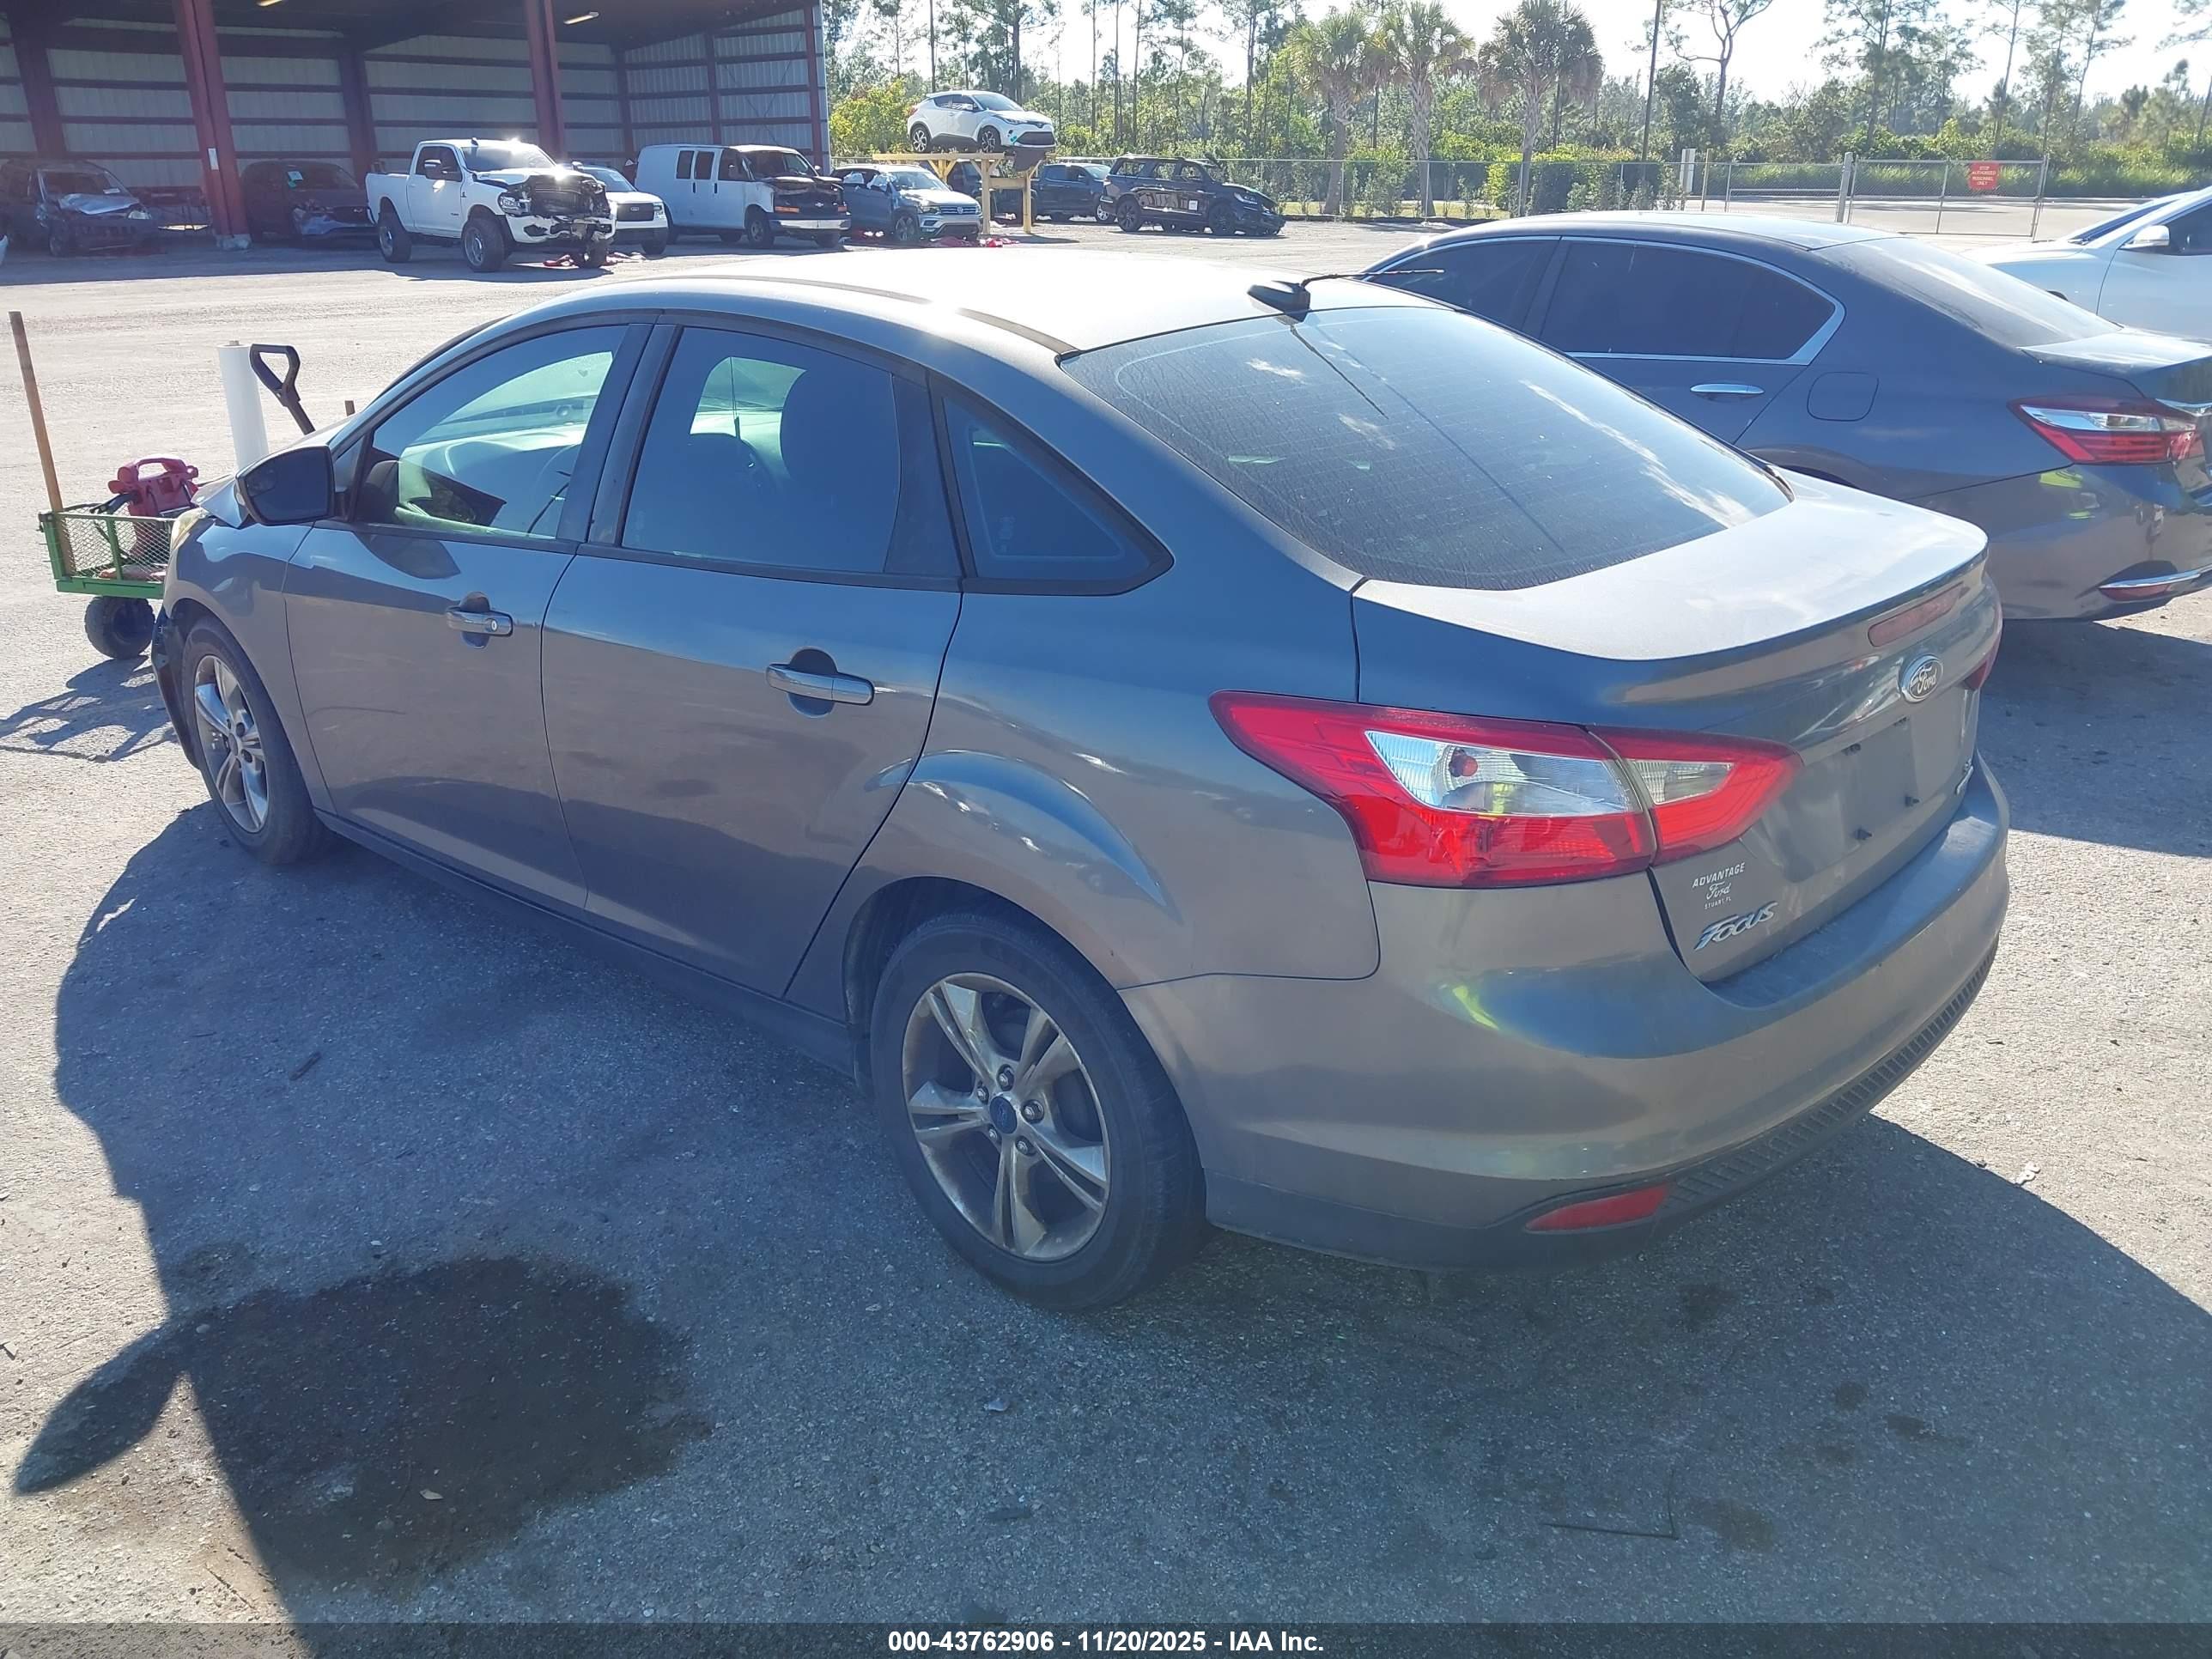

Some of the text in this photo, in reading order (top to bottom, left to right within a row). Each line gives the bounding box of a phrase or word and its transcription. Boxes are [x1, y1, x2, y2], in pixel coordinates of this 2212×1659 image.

[1911, 665, 1937, 694] Ford
[1692, 862, 1745, 888] ADVANTAGE
[1706, 881, 1732, 900] Ford
[1705, 898, 1724, 909] STUART
